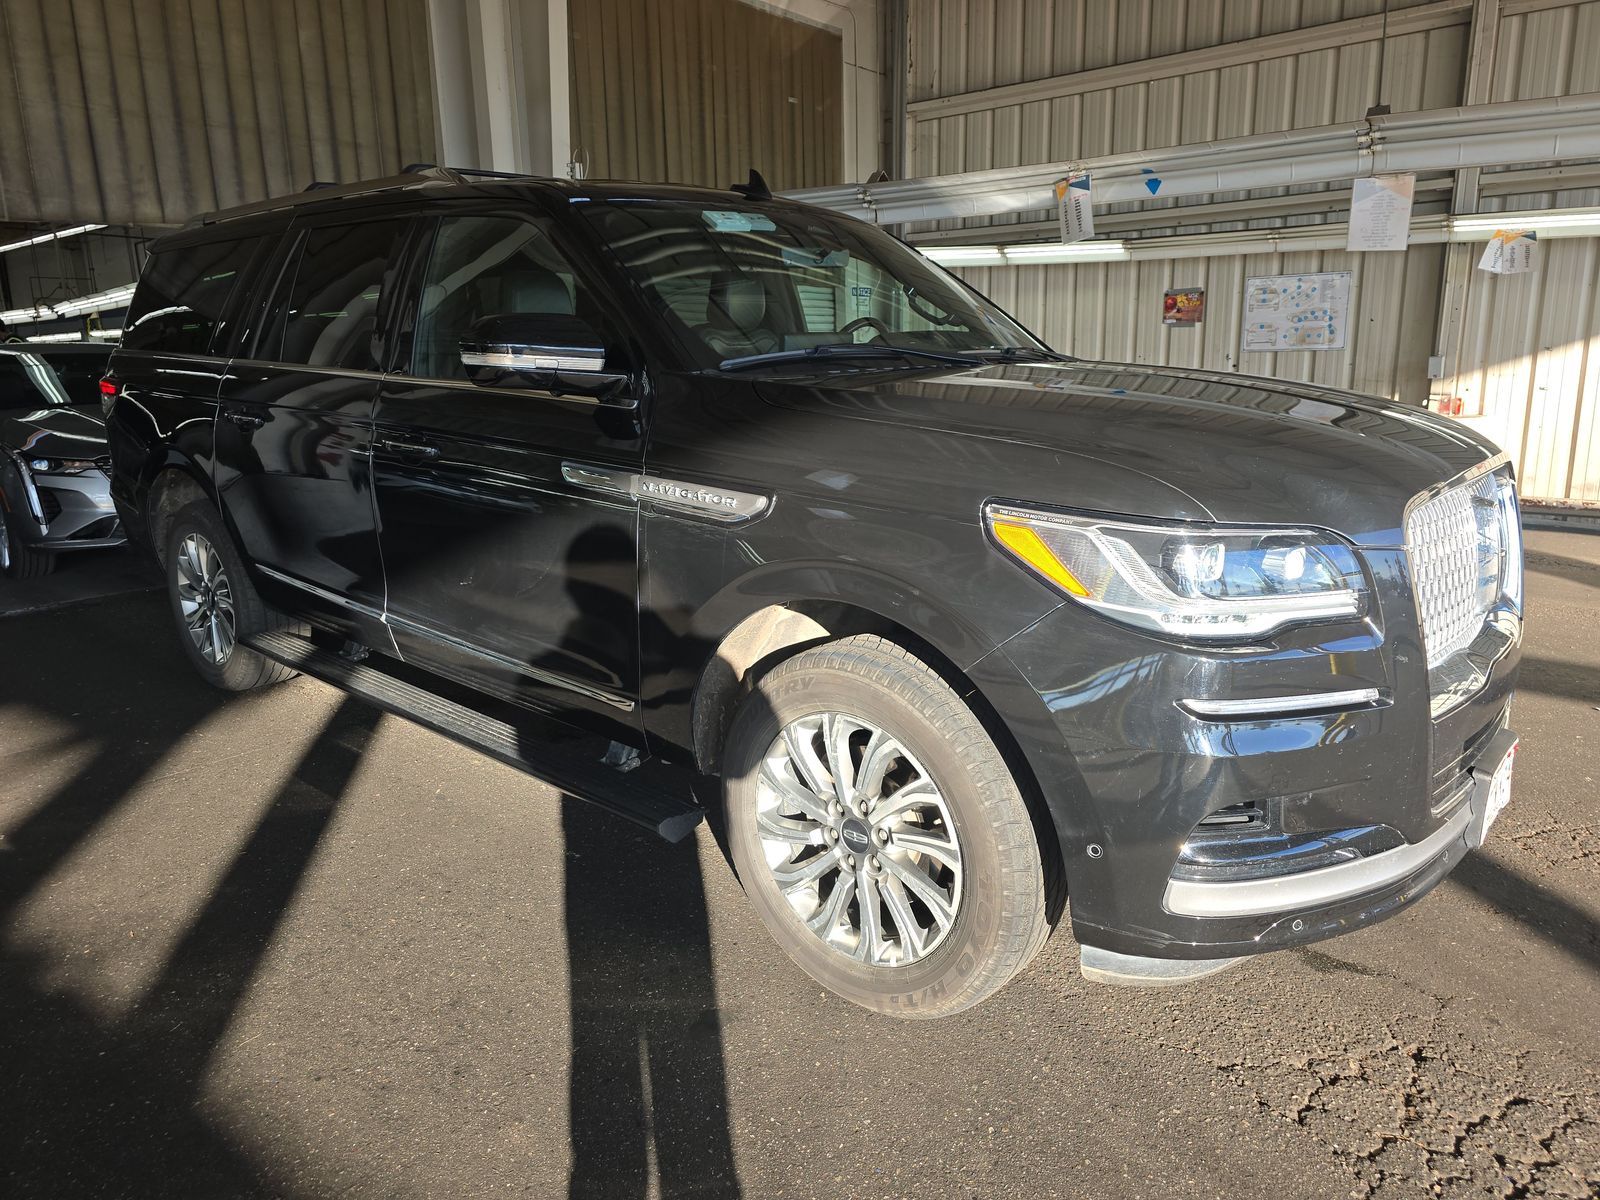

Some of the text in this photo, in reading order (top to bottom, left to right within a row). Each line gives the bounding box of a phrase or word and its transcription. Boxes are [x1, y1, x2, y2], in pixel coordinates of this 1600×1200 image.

[853, 288, 871, 296] NTICE
[643, 482, 737, 508] NAVIGATOR
[1048, 517, 1073, 525] COMPANY
